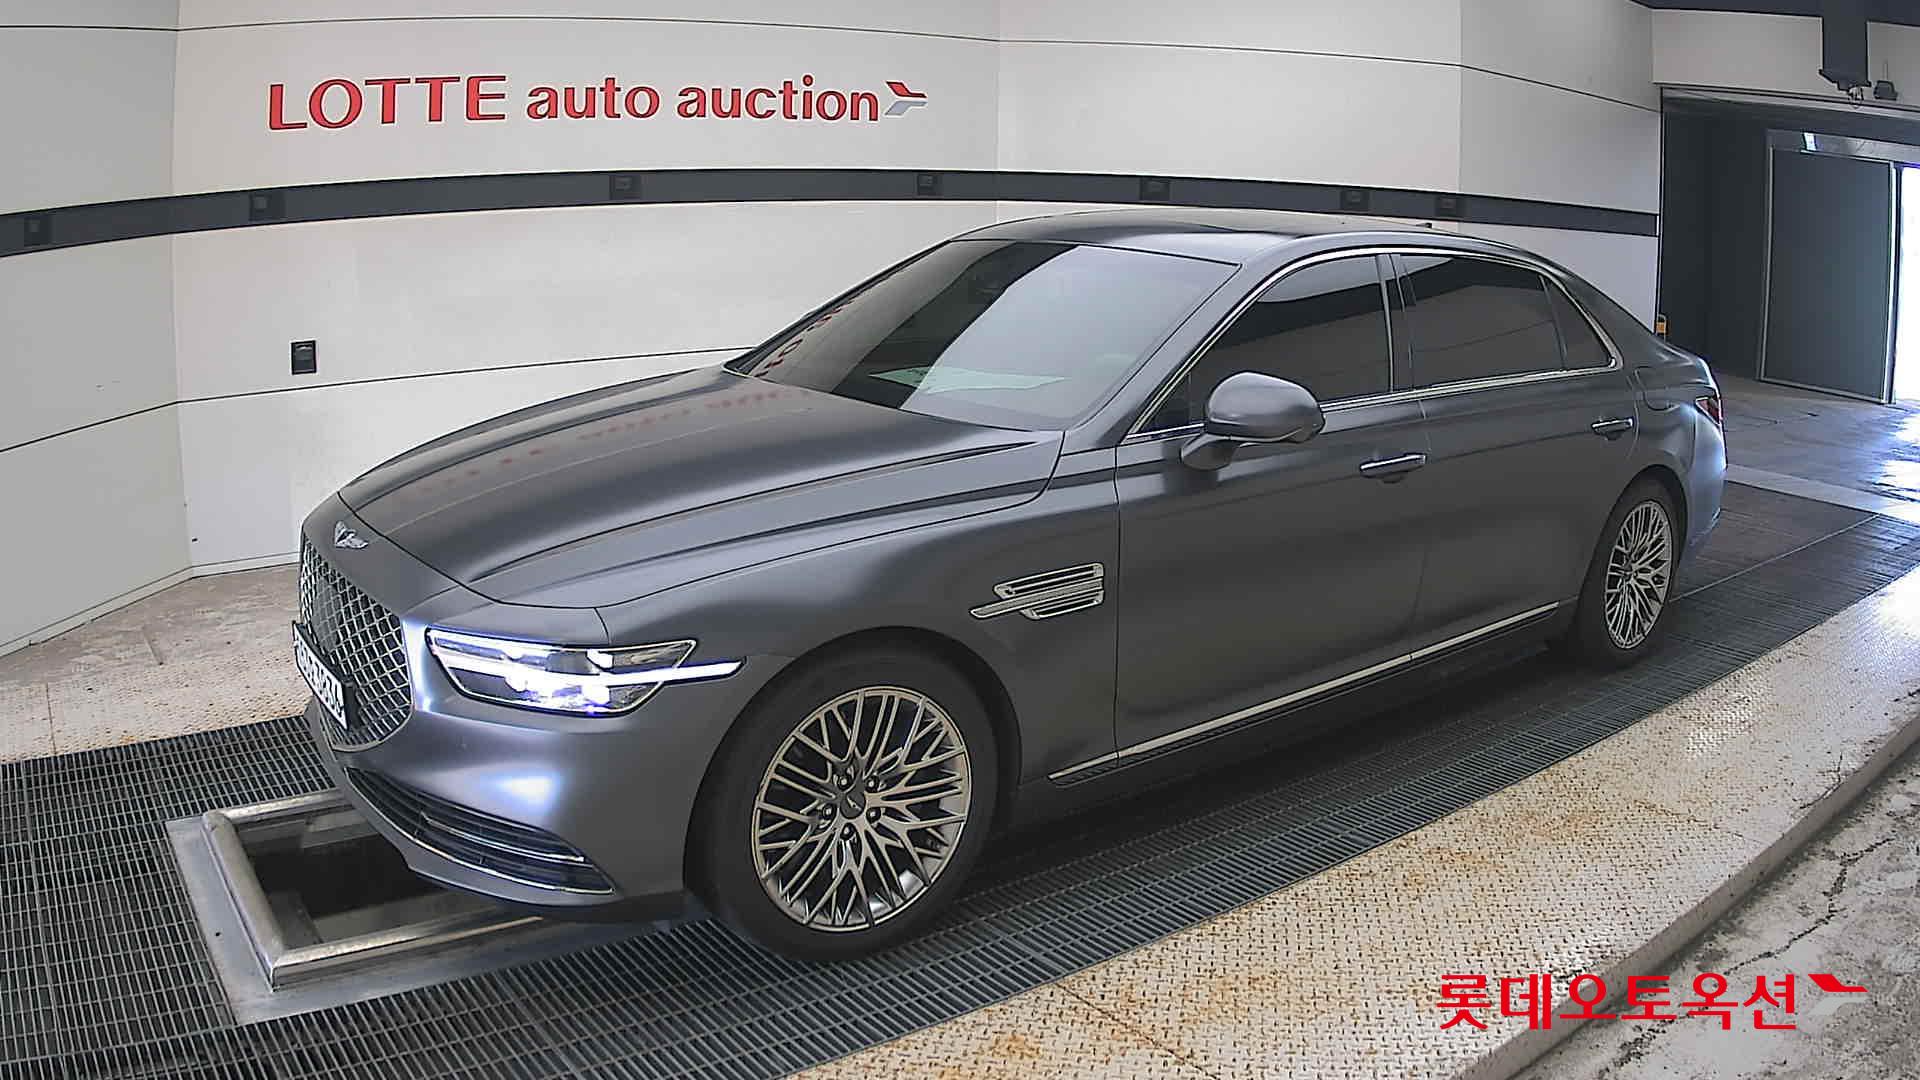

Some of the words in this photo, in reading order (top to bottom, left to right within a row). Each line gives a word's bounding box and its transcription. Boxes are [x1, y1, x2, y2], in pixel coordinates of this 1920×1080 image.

[268, 75, 507, 131] LOTTE
[527, 77, 660, 120] auto
[677, 75, 880, 122] auction
